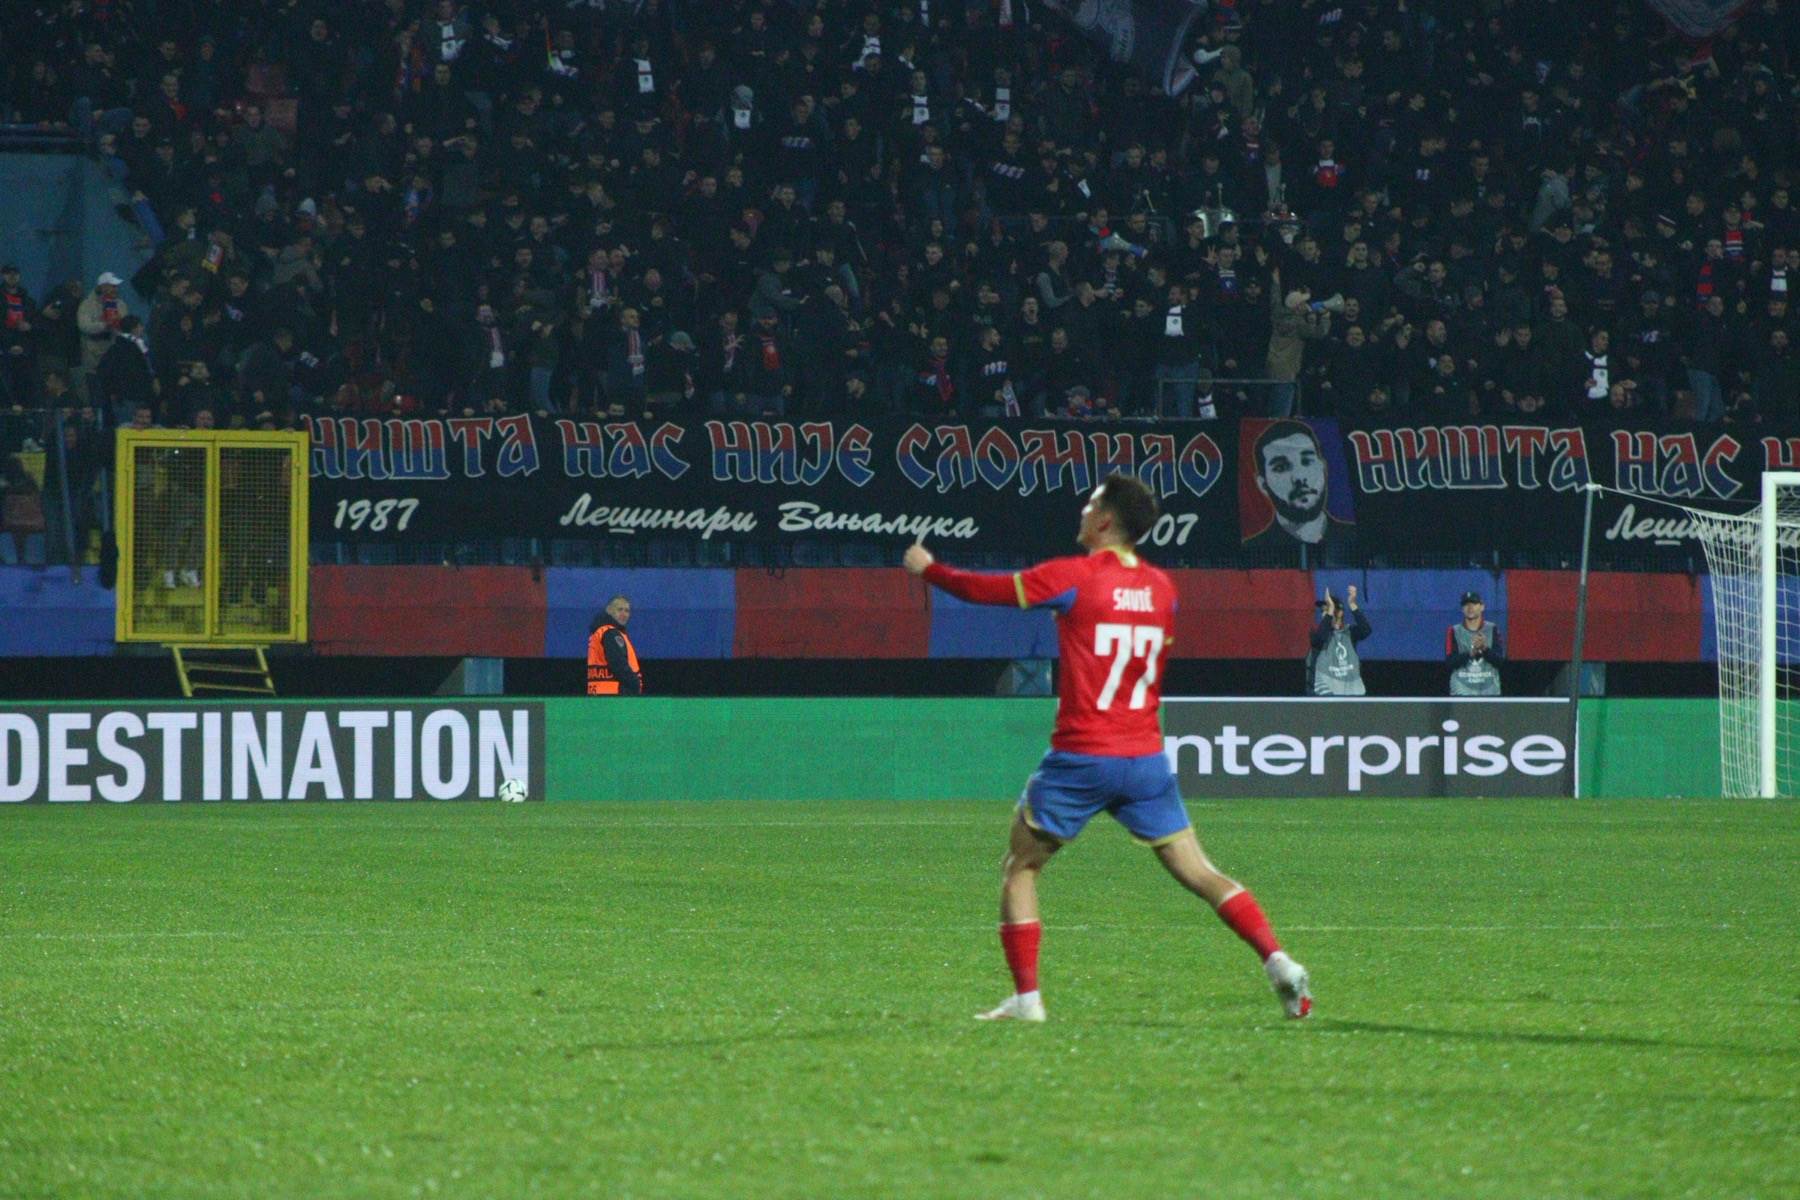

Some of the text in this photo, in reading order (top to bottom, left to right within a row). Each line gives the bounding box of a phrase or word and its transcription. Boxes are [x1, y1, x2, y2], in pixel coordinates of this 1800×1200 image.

[334, 498, 419, 532] 1987
[1094, 623, 1164, 711] 77
[0, 709, 529, 802] DESTINATION
